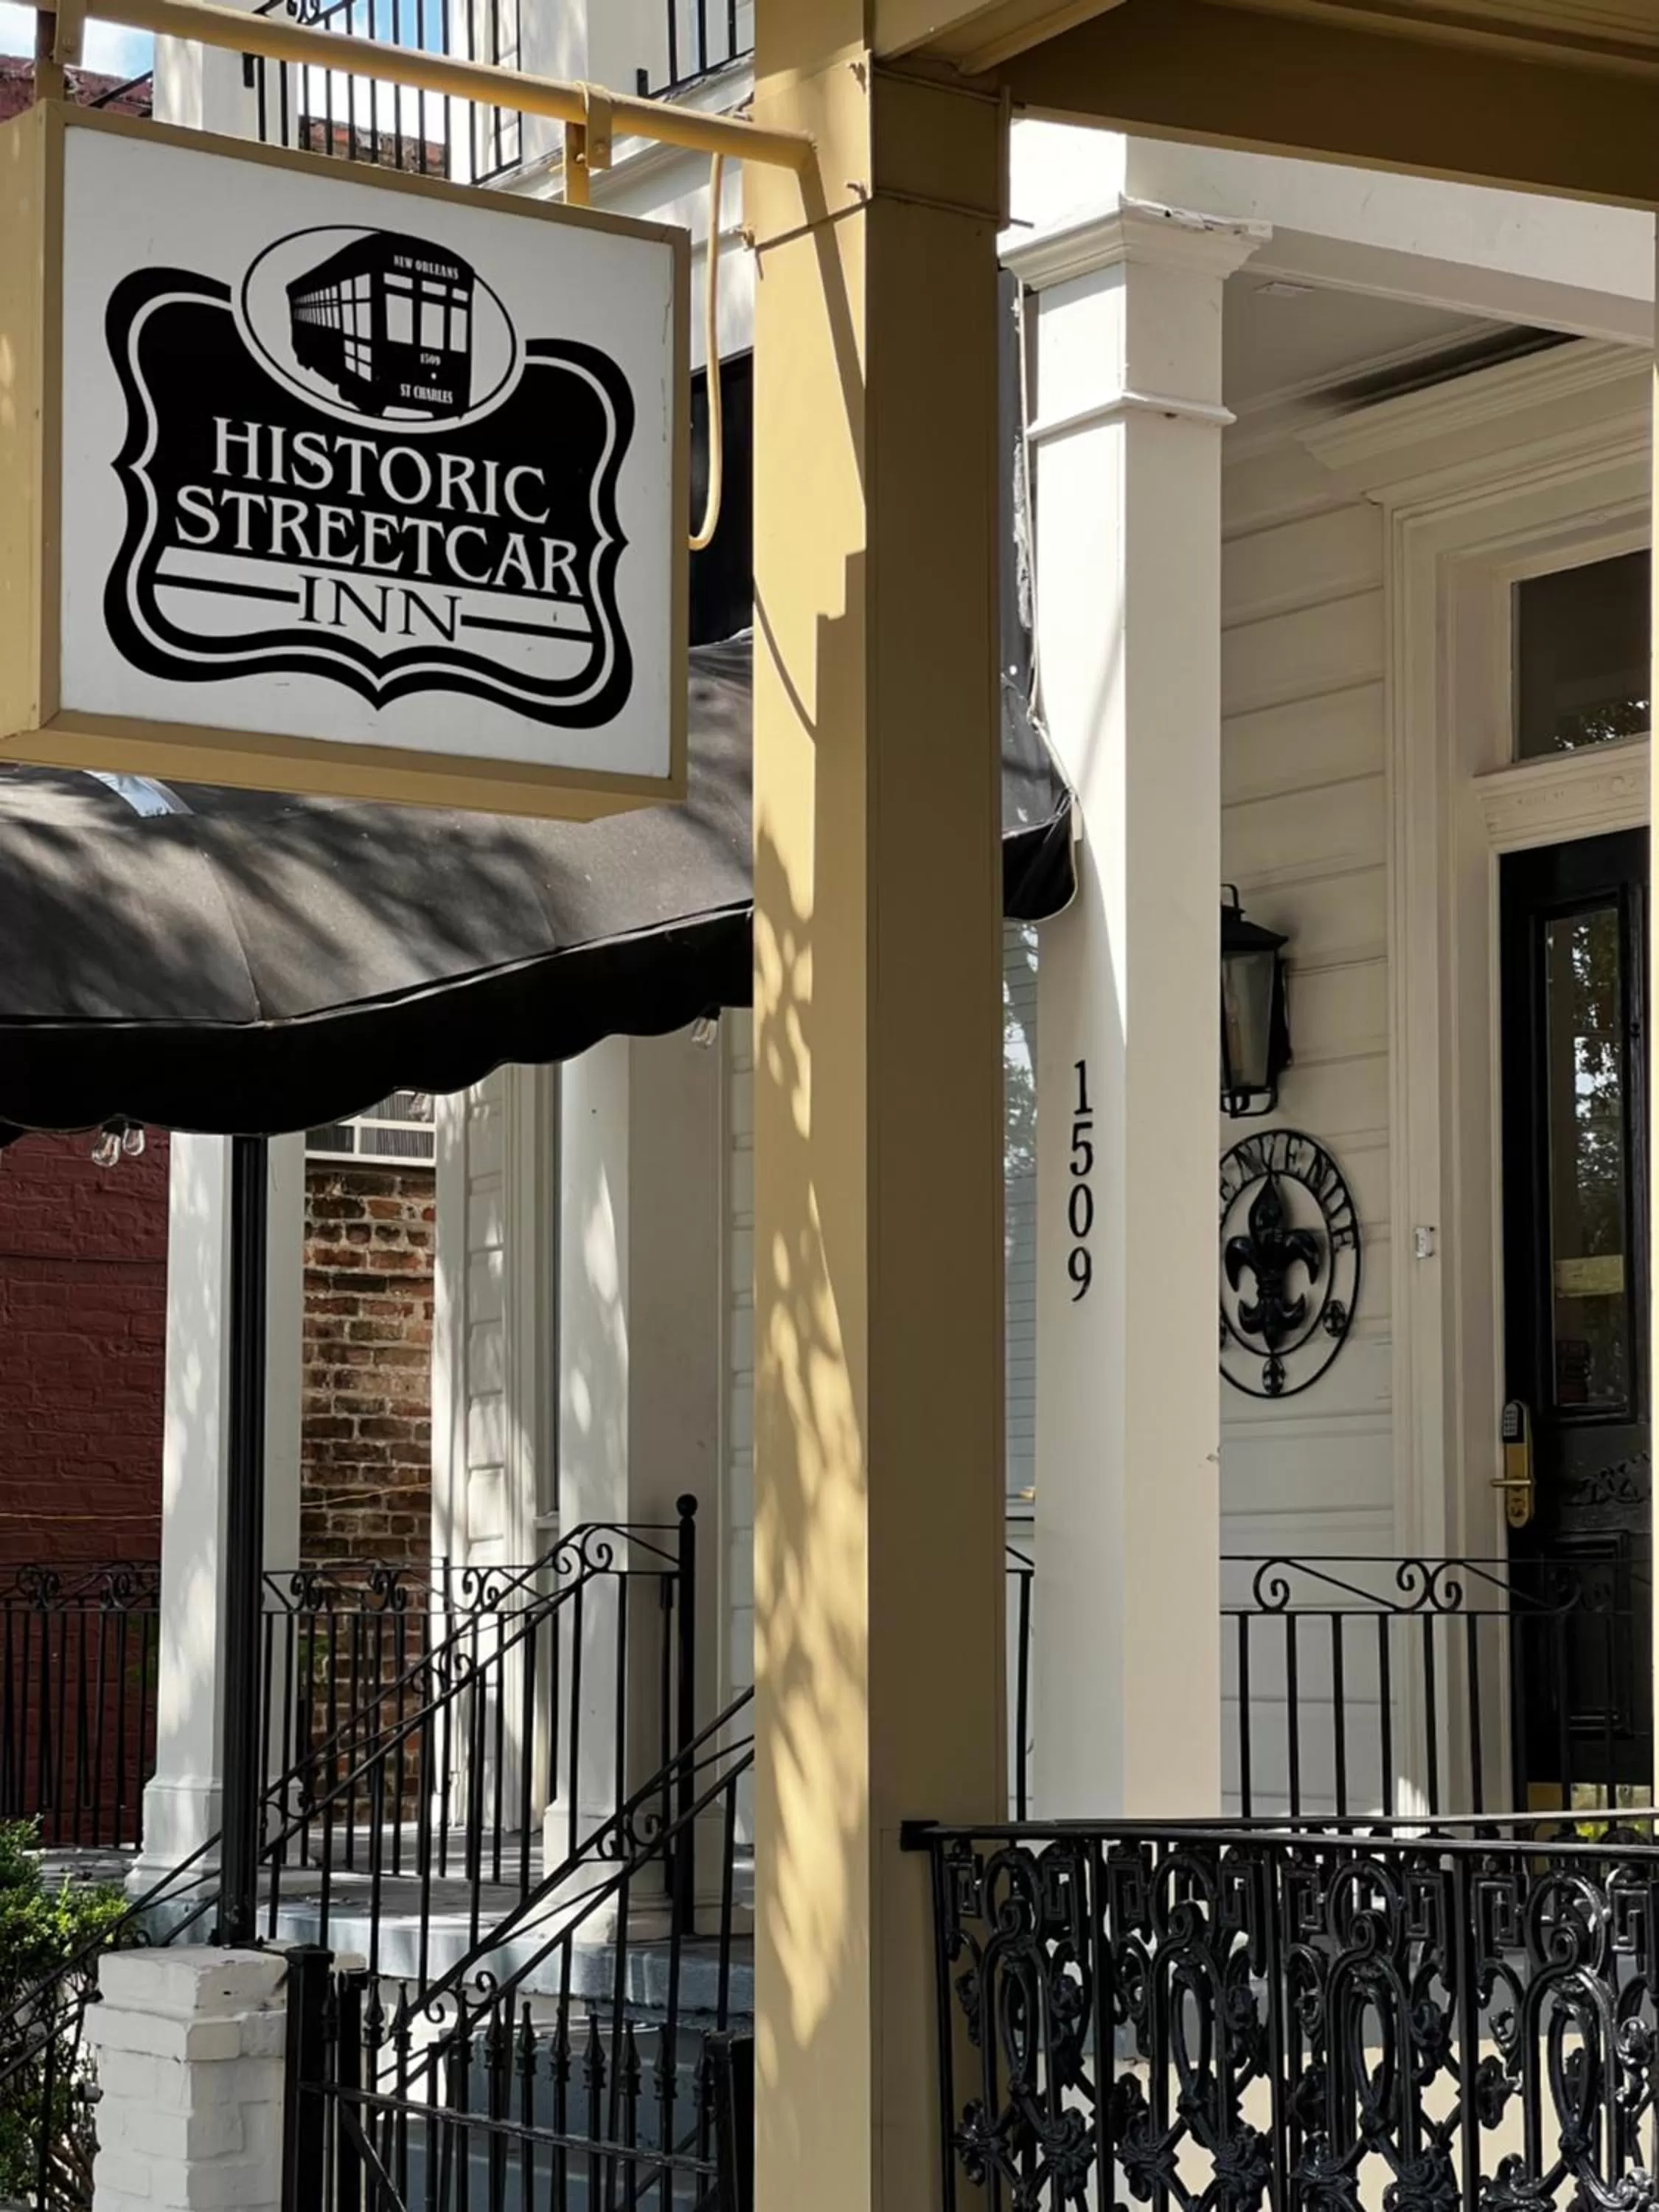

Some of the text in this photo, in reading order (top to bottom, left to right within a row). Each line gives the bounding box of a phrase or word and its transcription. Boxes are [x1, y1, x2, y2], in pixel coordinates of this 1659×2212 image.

[393, 254, 459, 280] NEW ORLEANS
[420, 352, 441, 366] 1509
[400, 383, 453, 405] ST CHARLES
[212, 417, 550, 524] HISTORIC
[175, 485, 582, 598] STREETCAR
[299, 575, 461, 642] INN
[1068, 1060, 1093, 1302] 1509
